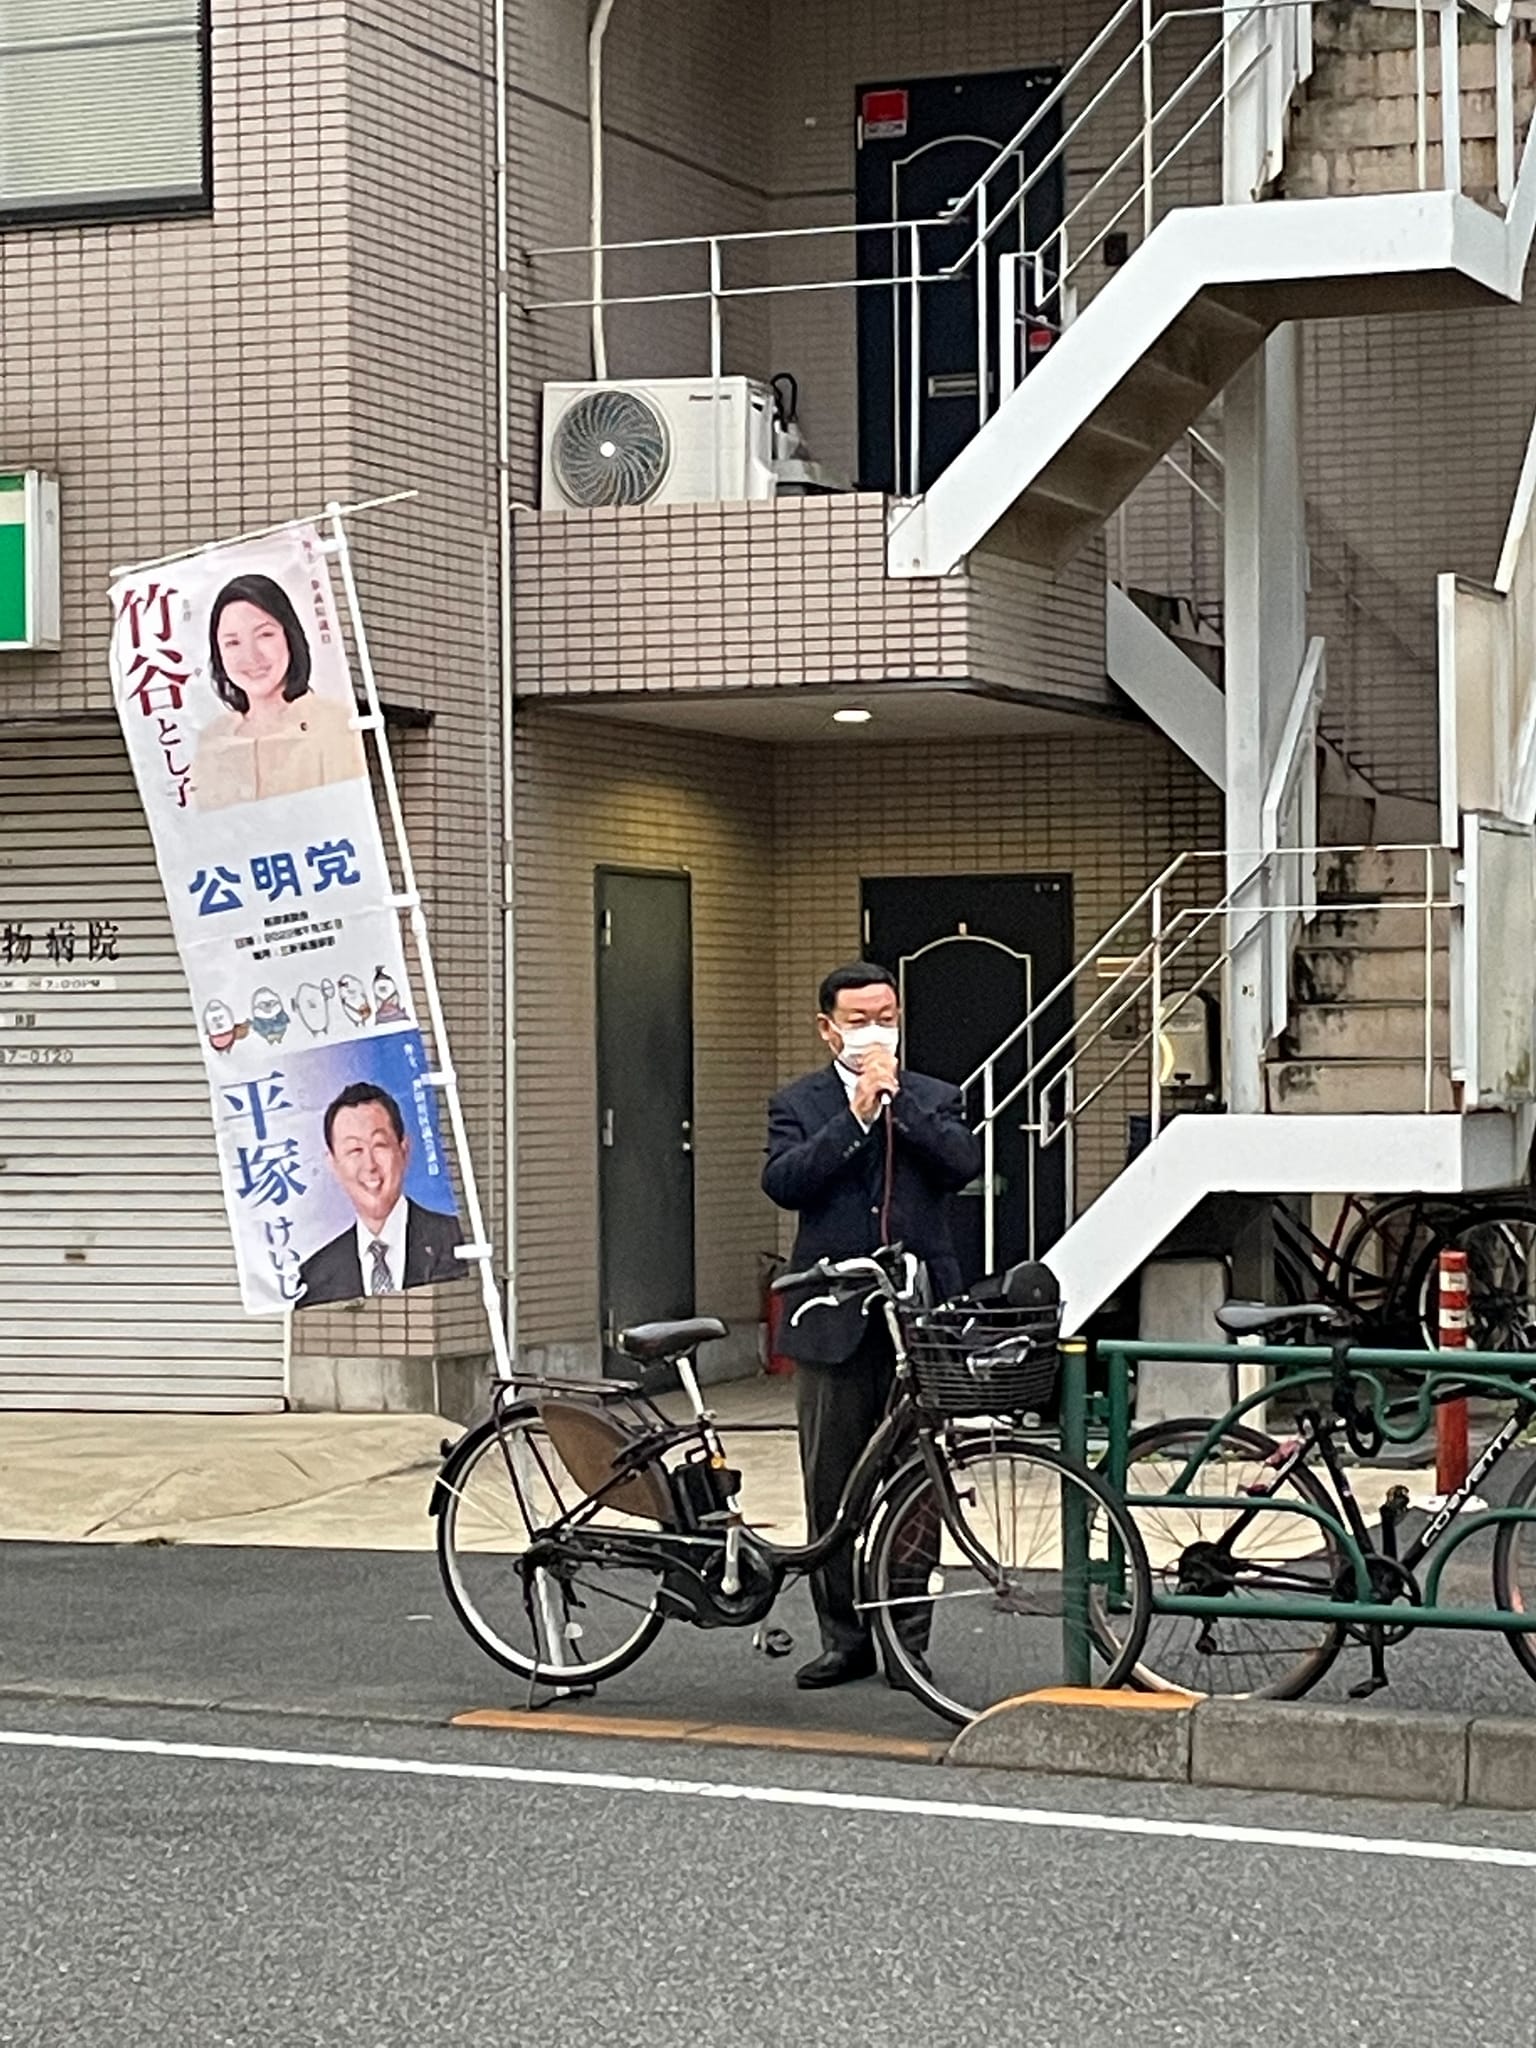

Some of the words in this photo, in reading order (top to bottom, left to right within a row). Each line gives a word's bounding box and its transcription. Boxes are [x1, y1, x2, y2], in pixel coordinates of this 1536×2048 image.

[117, 583, 198, 808] 竹谷とし子
[2, 920, 120, 966] 物病院
[190, 838, 361, 916] 公明党
[219, 1070, 308, 1301] 平塚けいじ
